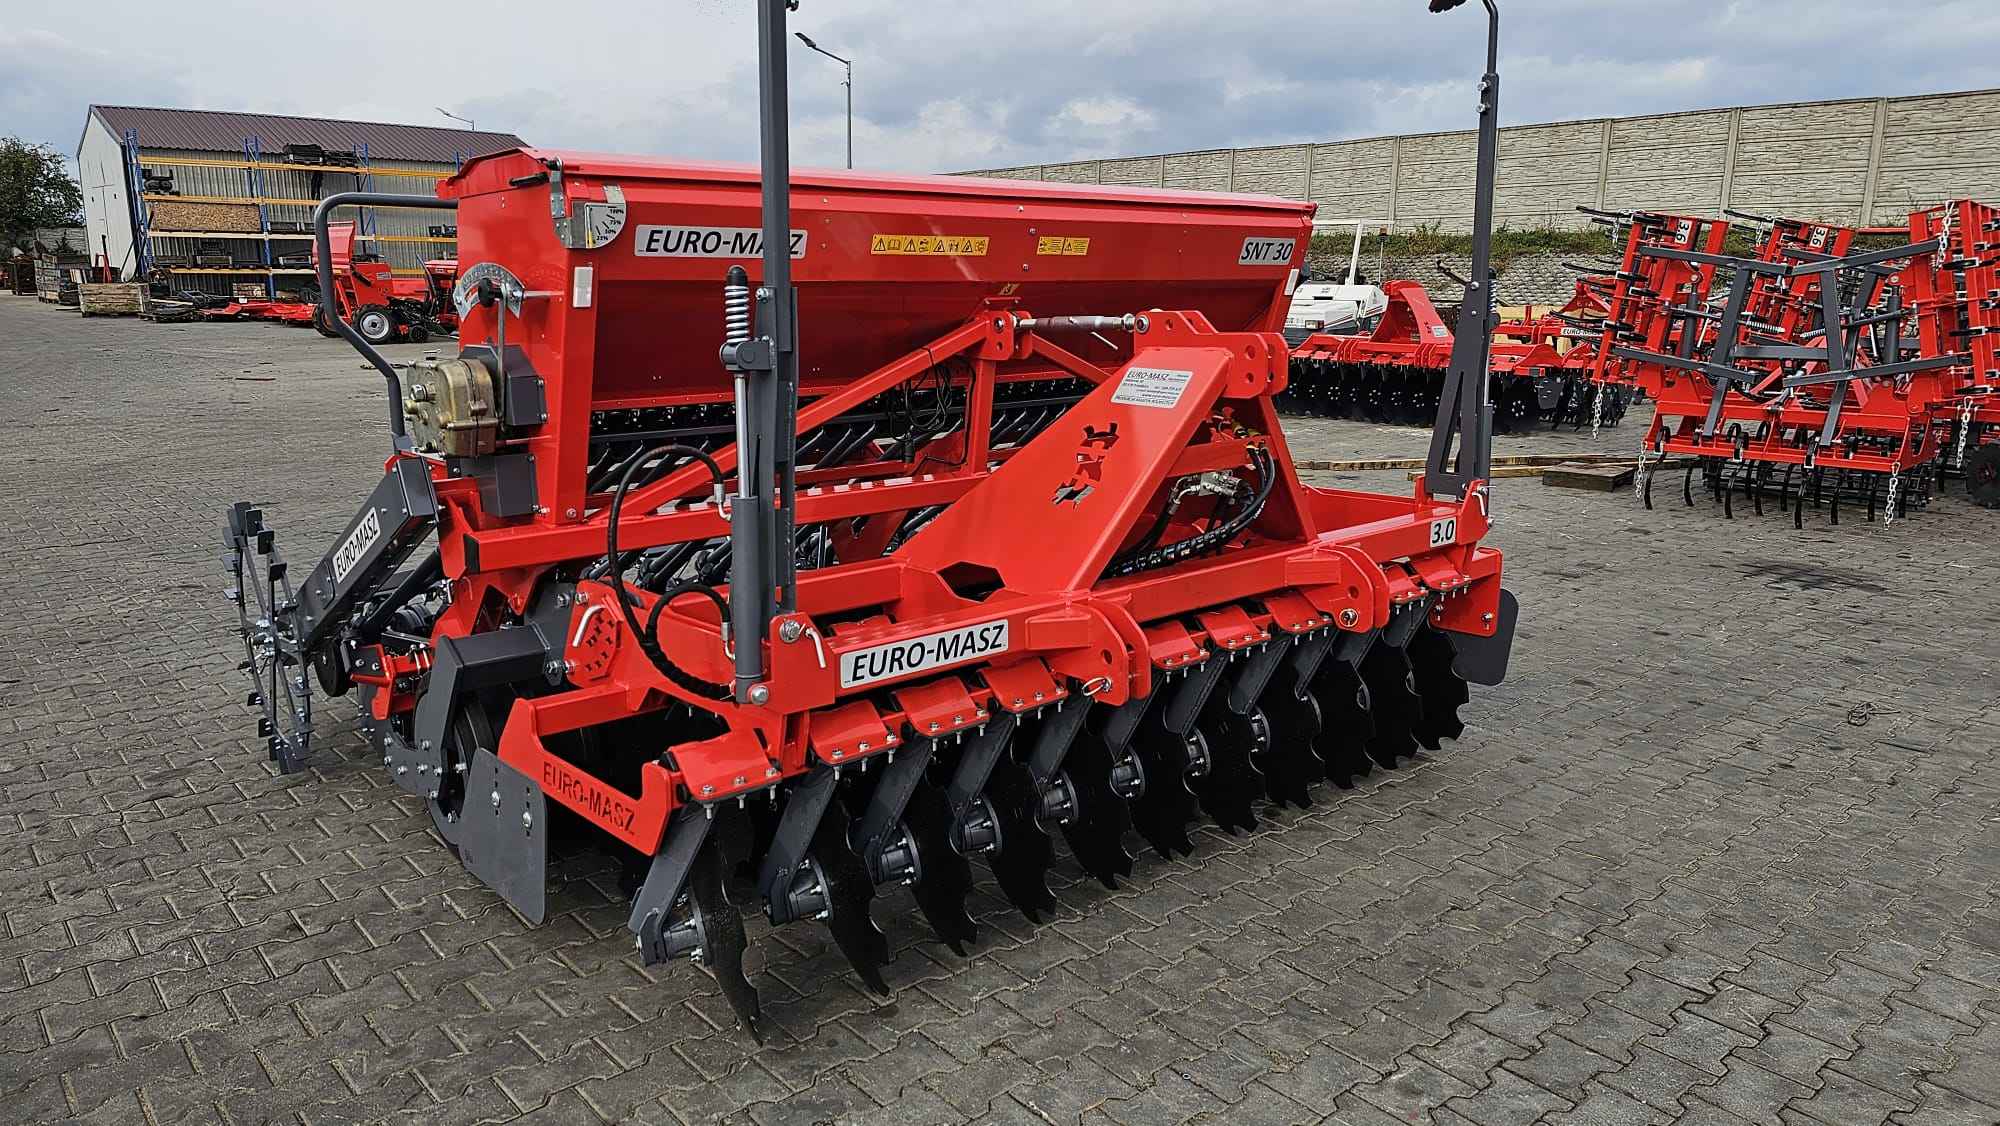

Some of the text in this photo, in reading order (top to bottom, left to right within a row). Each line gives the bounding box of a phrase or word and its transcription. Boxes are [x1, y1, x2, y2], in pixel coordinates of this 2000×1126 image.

[645, 229, 803, 256] EURO-MZ
[1676, 221, 1689, 242] 3.6
[1812, 227, 1825, 246] 3.6
[1241, 242, 1293, 260] SNT 30
[1126, 370, 1170, 381] EURO-MASZ
[336, 511, 378, 577] EURO-MASZ
[1431, 519, 1455, 544] 3.0
[851, 623, 1005, 682] EURO-MASZ
[543, 760, 635, 836] EURO-MASZ
